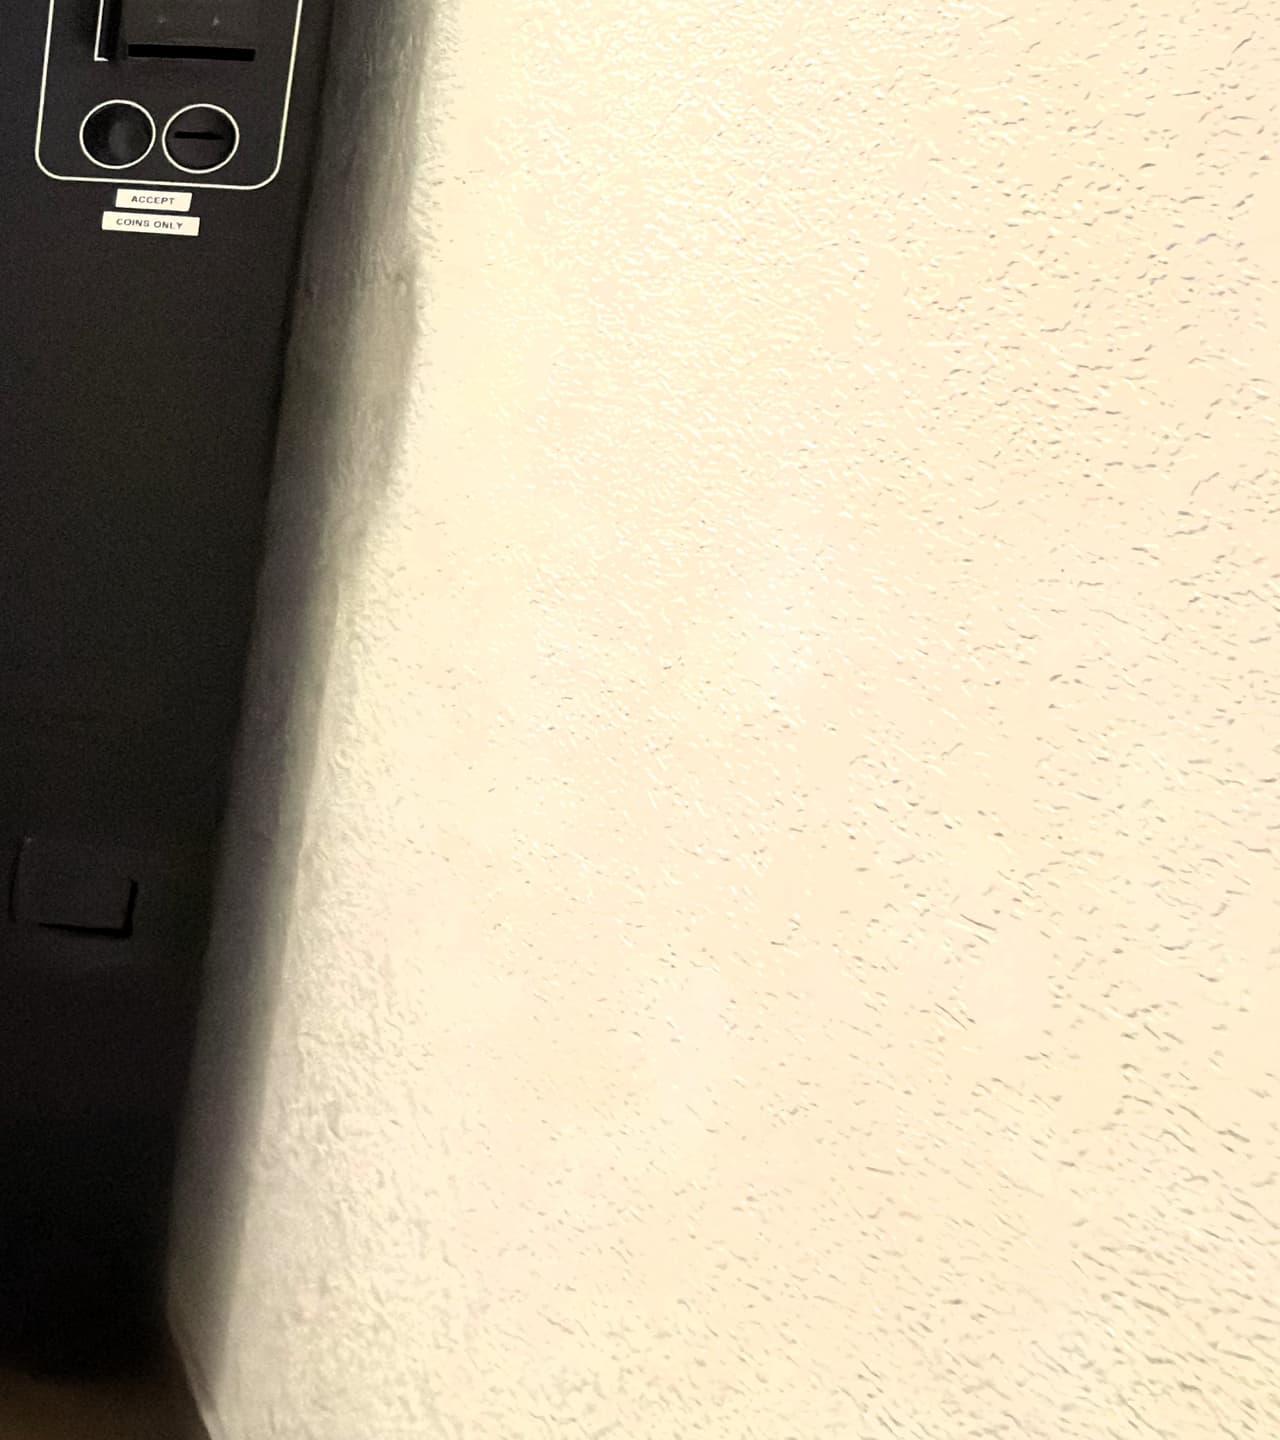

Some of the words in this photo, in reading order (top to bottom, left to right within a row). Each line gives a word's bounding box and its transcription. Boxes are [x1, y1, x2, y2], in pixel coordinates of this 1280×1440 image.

[130, 194, 175, 206] ACCEPT
[115, 218, 151, 229] COINS
[153, 220, 184, 231] ONLY
